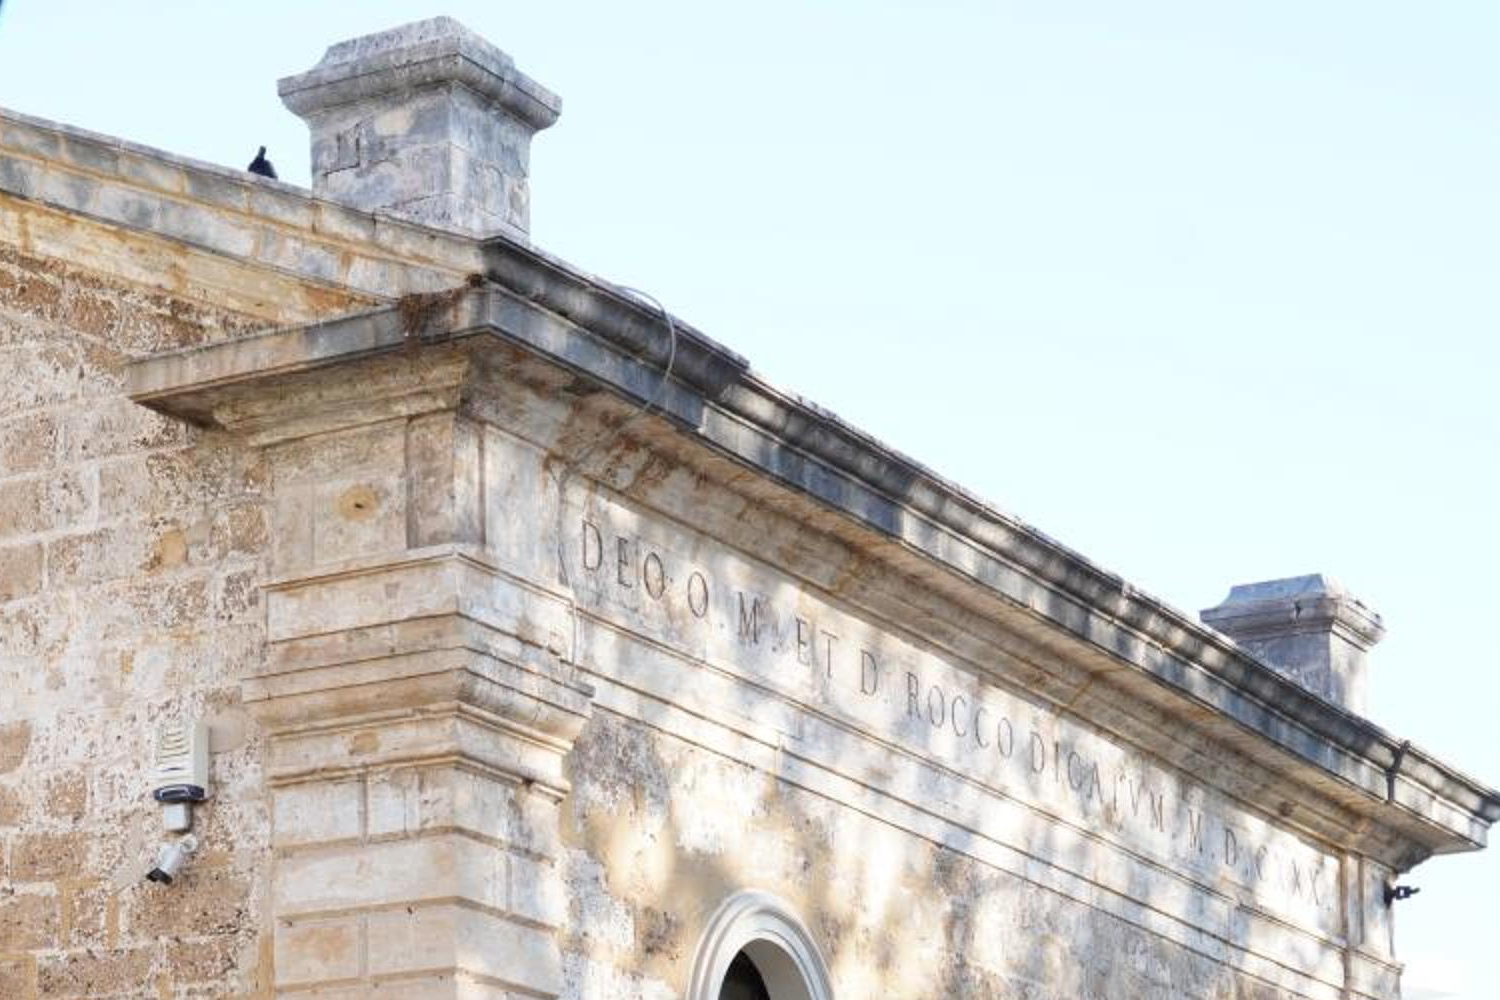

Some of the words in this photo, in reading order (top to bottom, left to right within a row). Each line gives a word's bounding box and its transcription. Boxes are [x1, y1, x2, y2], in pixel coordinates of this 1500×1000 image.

[582, 521, 665, 601] DEO
[795, 616, 839, 679] ET
[906, 671, 1013, 759] ROCCO
